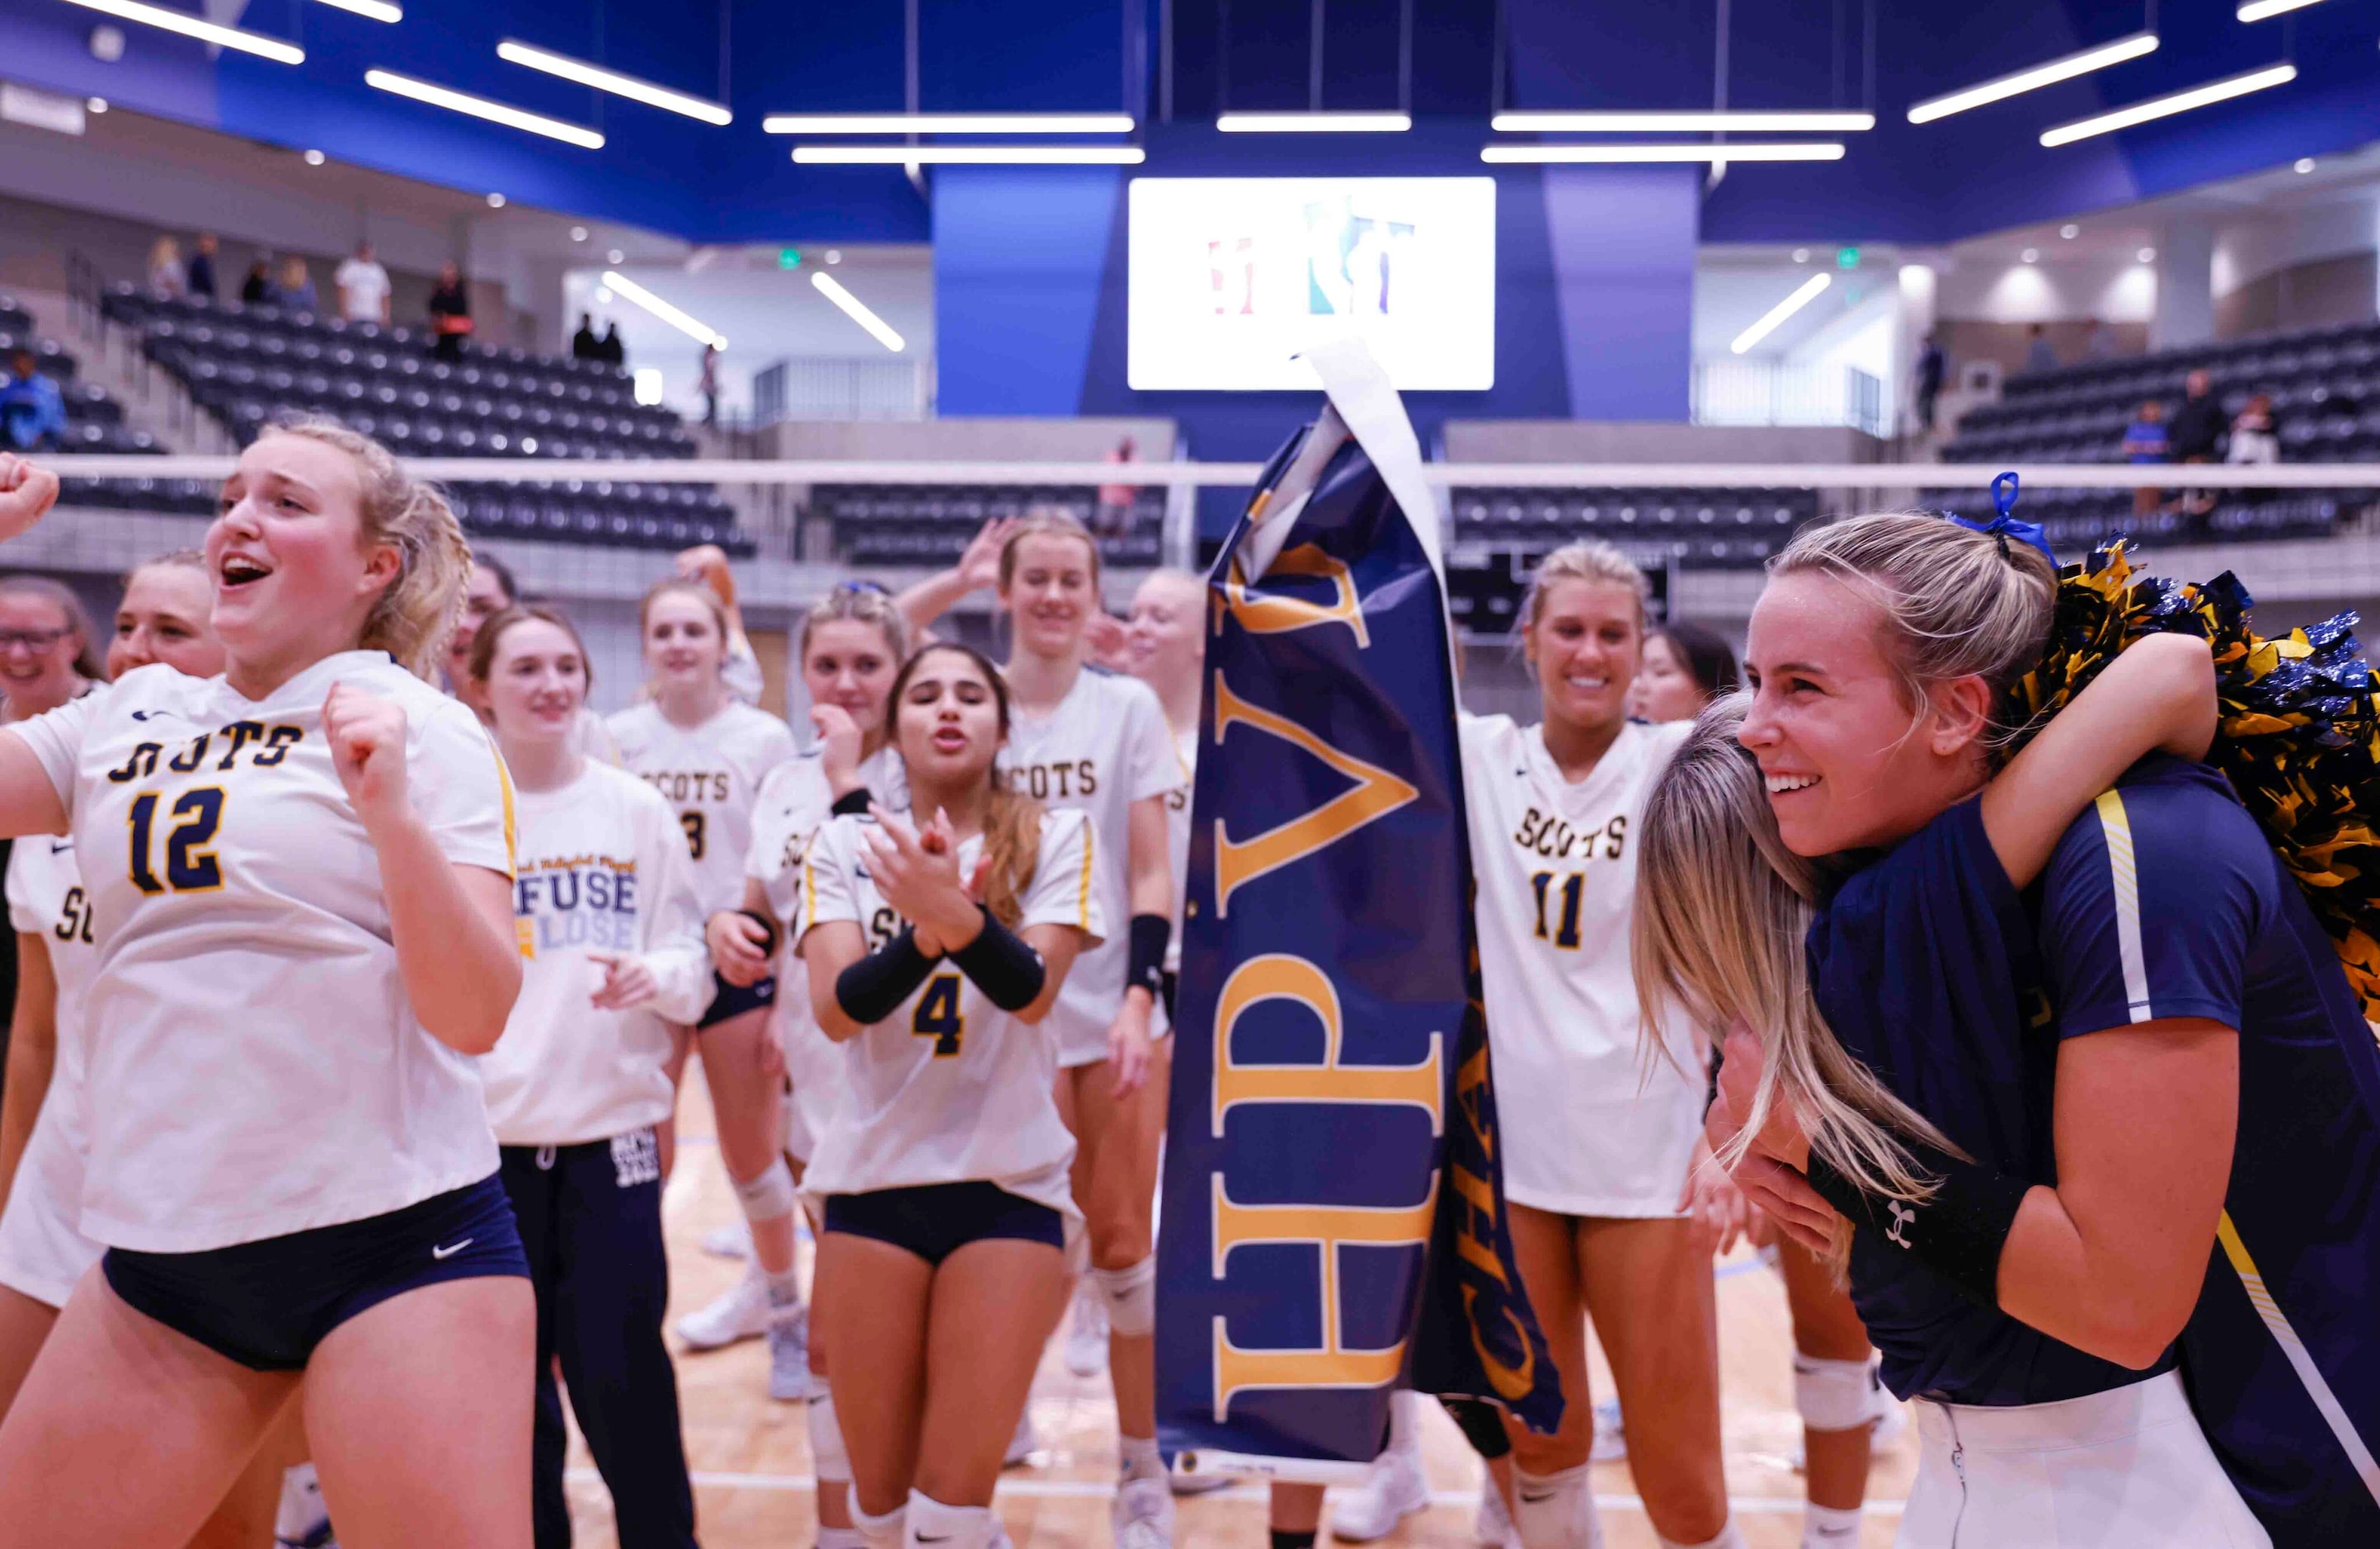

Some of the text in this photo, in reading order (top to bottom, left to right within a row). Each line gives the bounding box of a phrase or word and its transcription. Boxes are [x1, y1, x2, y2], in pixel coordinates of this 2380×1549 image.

[1009, 760, 1098, 800] COTS
[126, 784, 228, 897] 12
[1515, 807, 1628, 860] SCOTS
[516, 870, 637, 916] FUSE
[1531, 869, 1586, 952] 11
[911, 971, 965, 1060] 4
